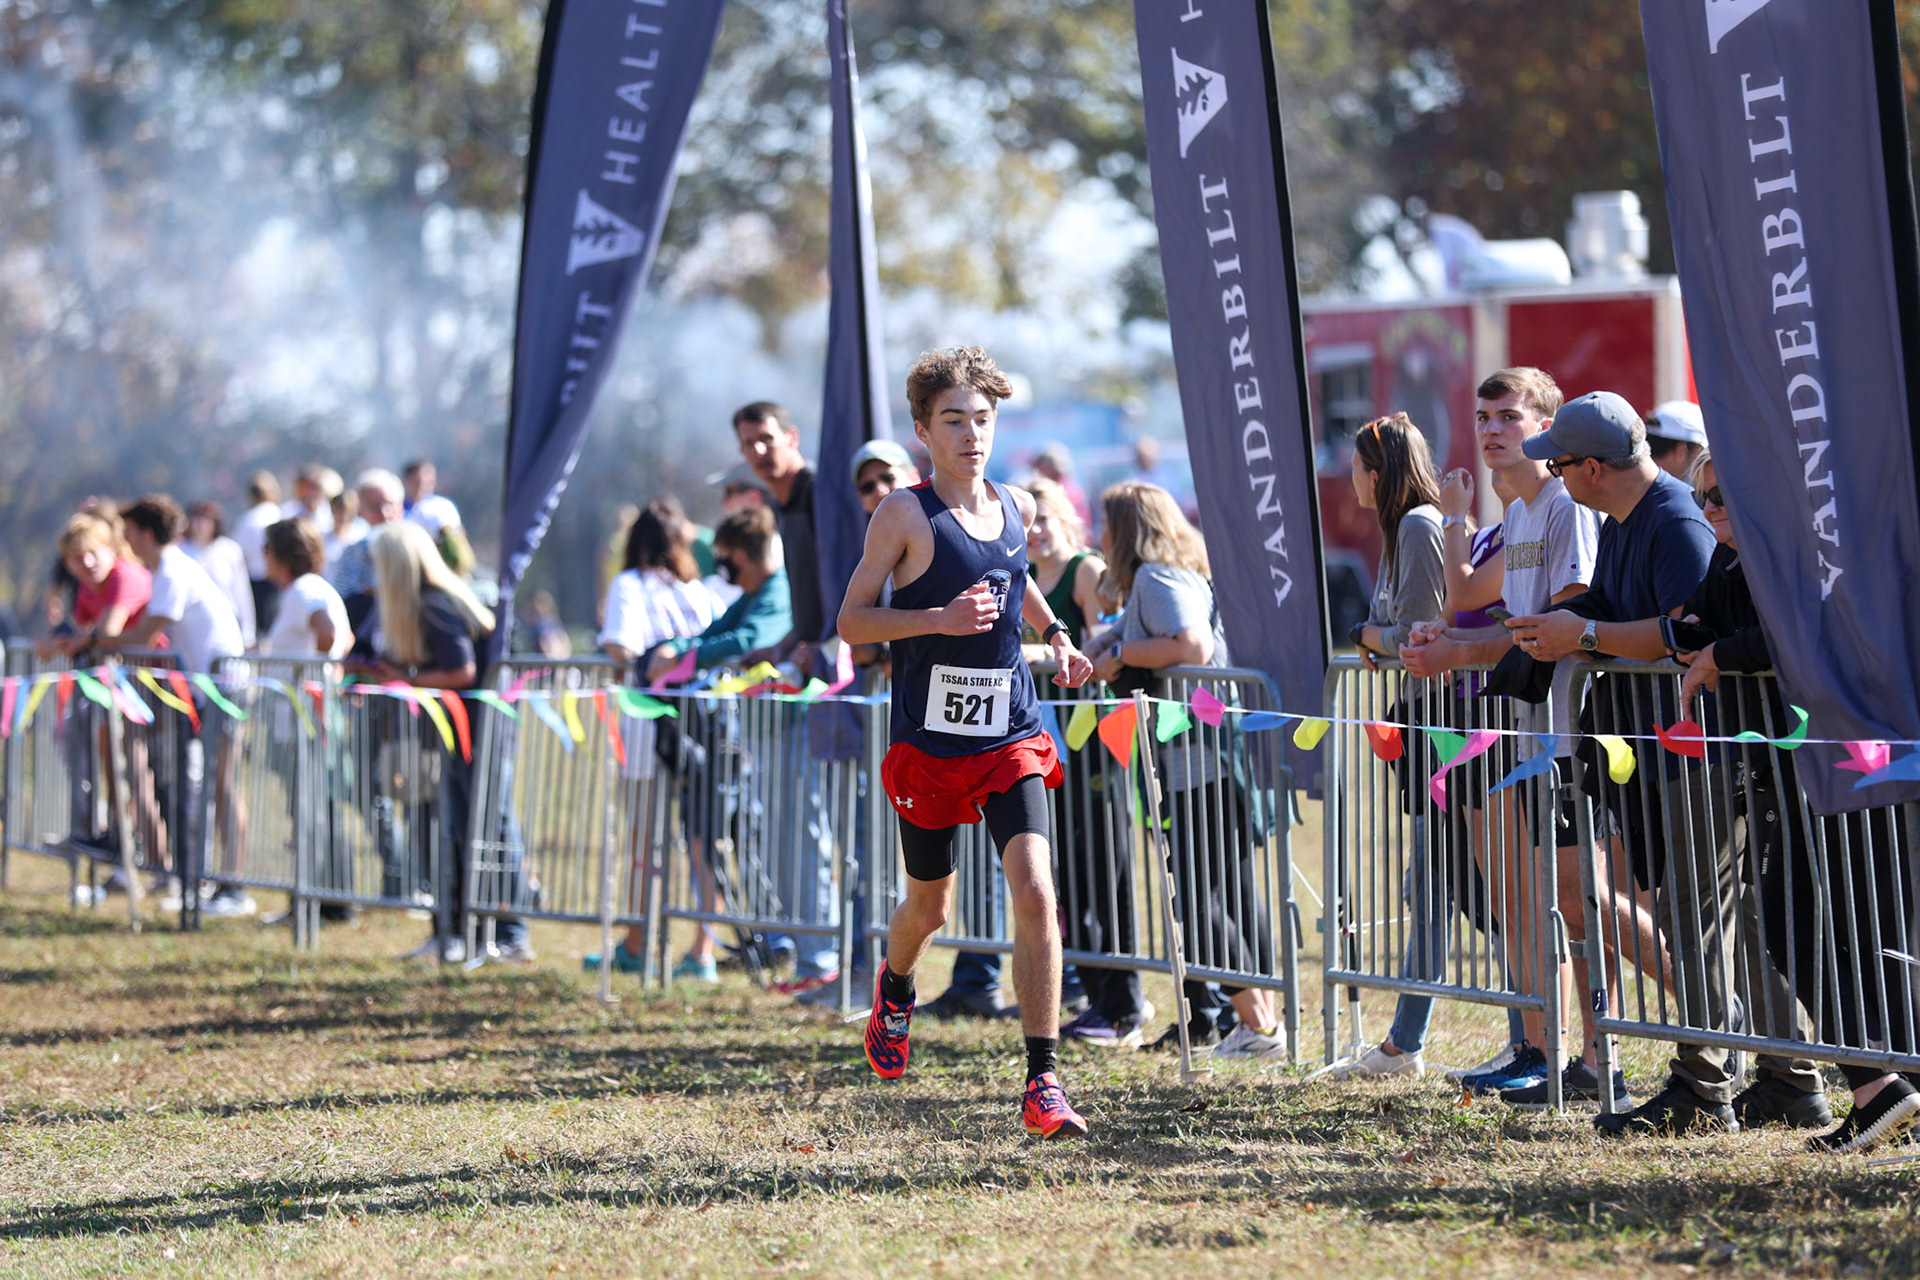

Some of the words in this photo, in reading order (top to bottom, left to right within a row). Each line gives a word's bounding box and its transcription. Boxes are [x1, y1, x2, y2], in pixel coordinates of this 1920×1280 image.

[1199, 173, 1293, 608] VANDERBILT
[1740, 72, 1844, 601] VANDERBILT
[941, 673, 968, 686] TSSAA
[970, 676, 992, 687] STATE
[993, 677, 1003, 687] XC
[944, 691, 994, 725] 521
